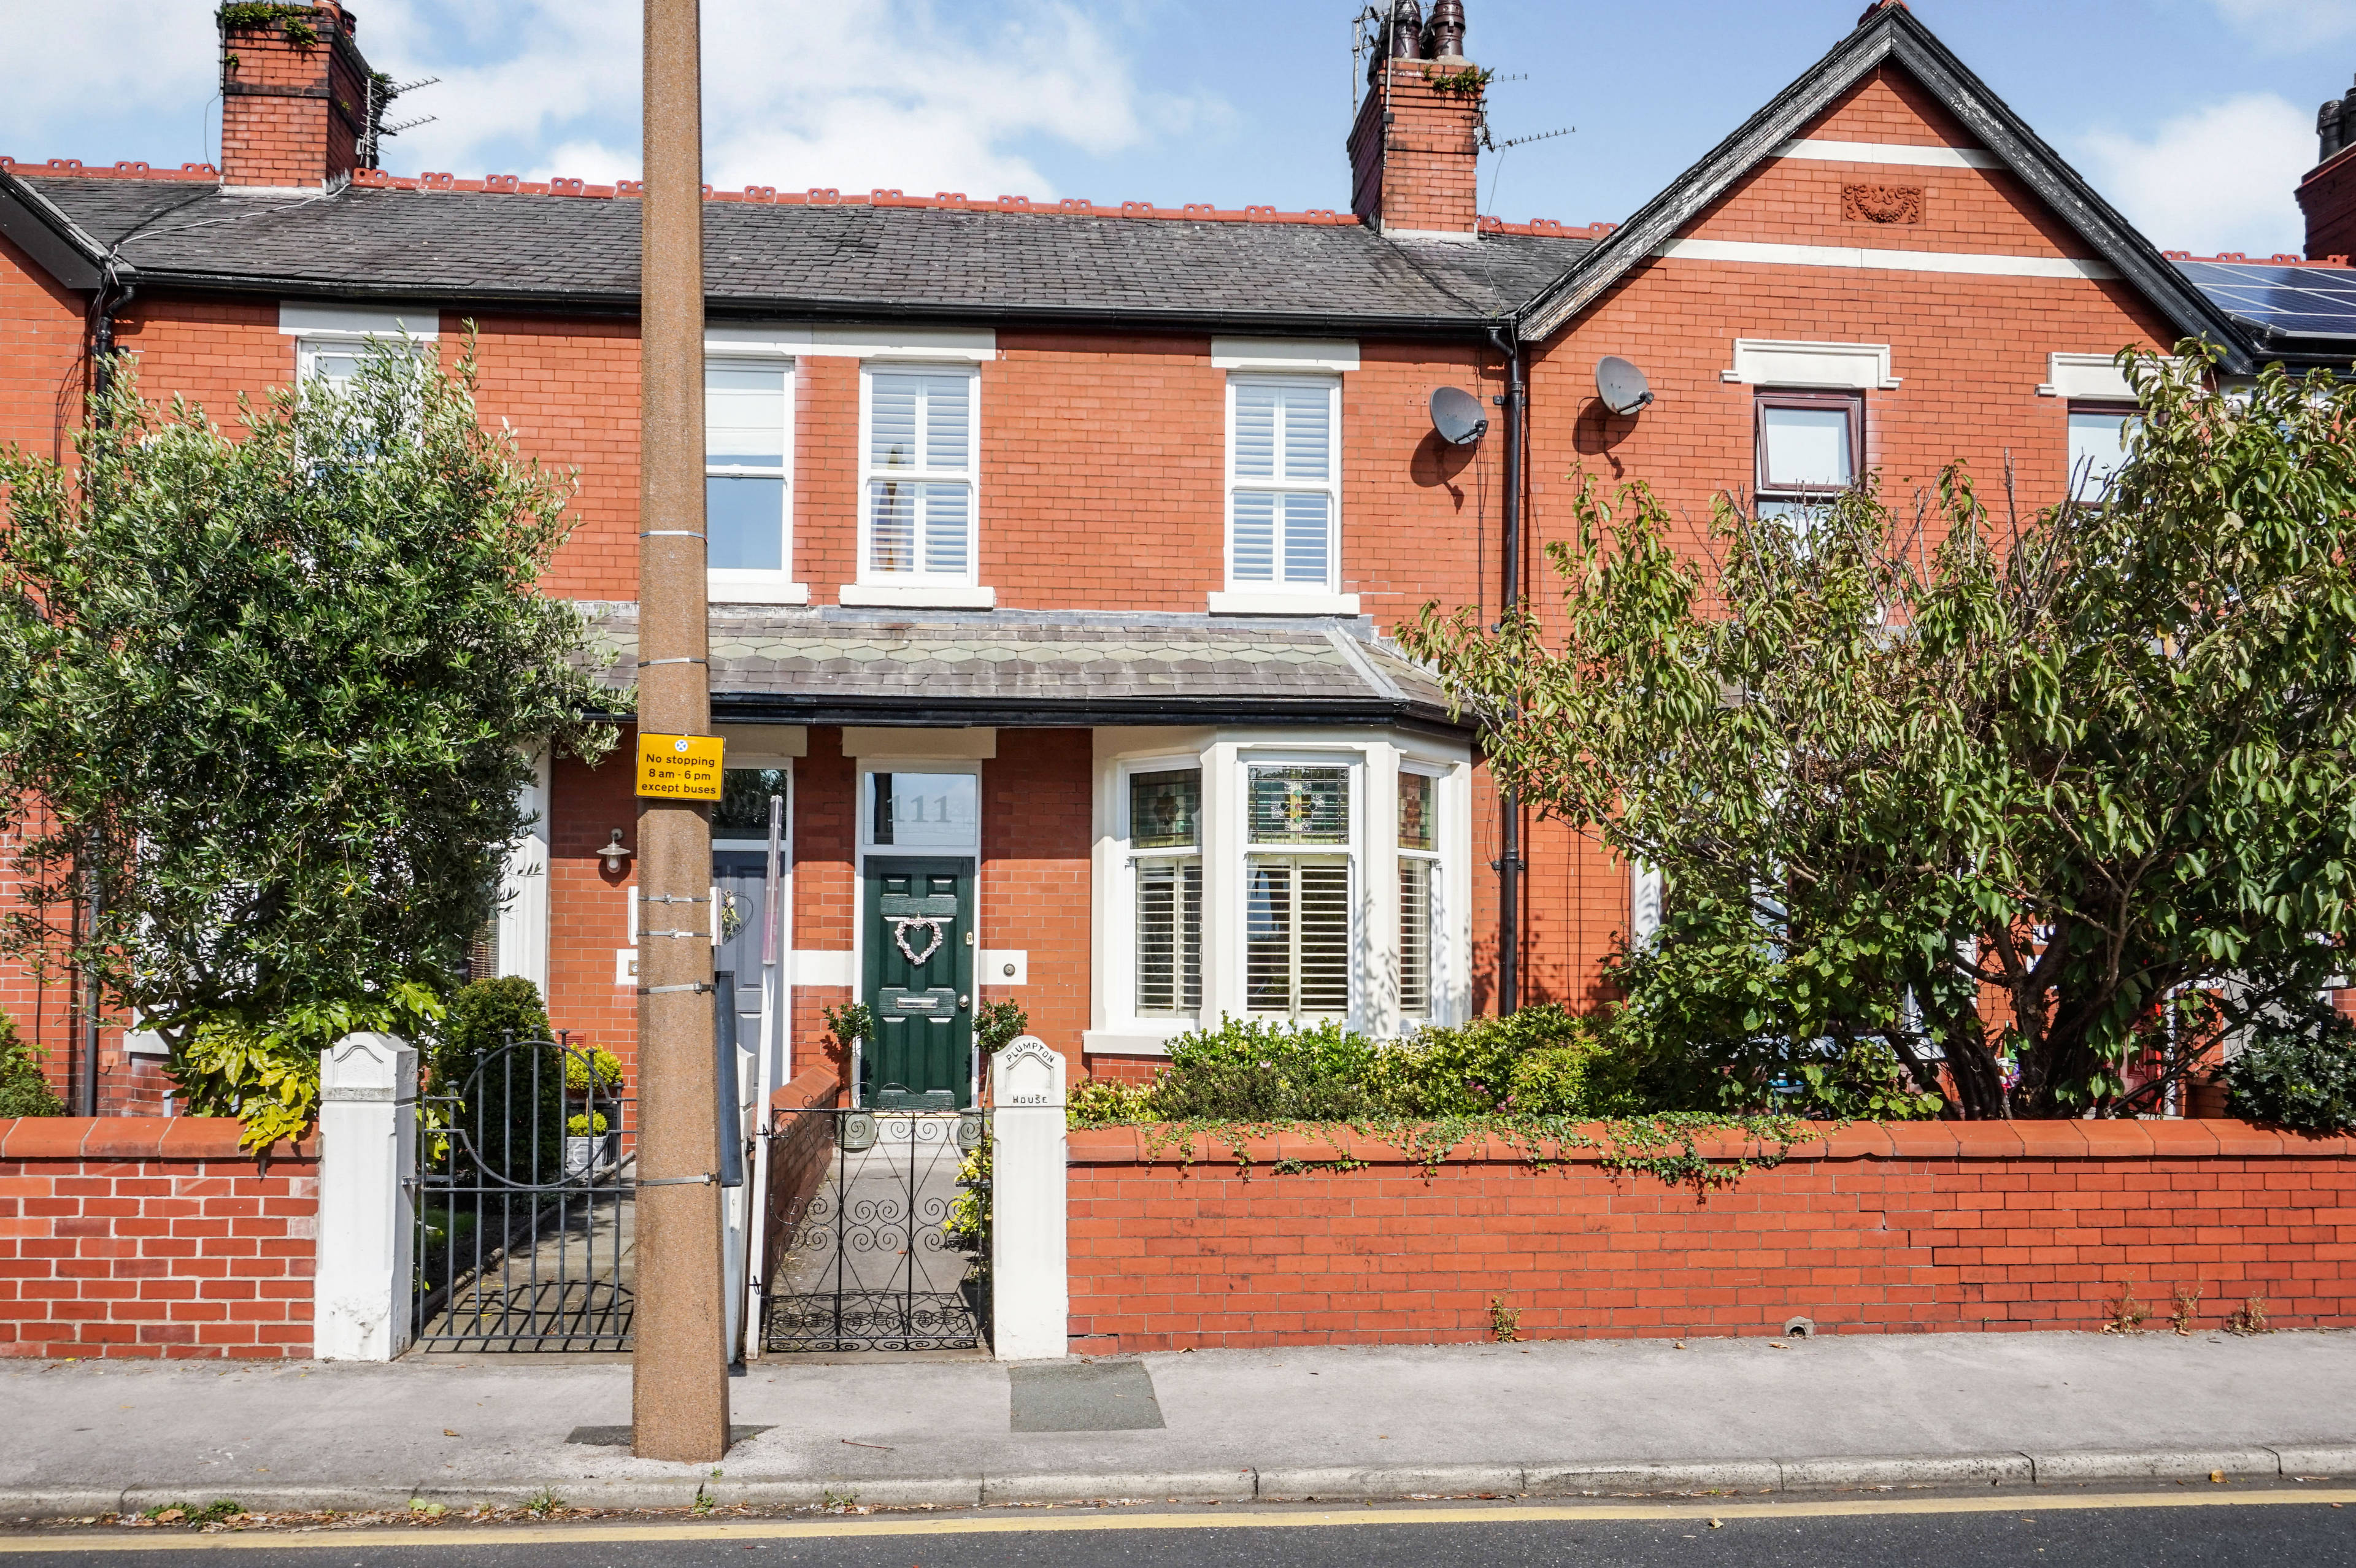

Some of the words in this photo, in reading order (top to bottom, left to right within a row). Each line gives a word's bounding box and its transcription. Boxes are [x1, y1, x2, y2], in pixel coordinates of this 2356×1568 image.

[646, 753, 661, 763] No
[666, 755, 715, 767] stopping
[642, 783, 679, 793] except
[683, 783, 716, 794] buses
[887, 794, 952, 823] 111
[1006, 1042, 1055, 1063] PLUMPTON
[1013, 1095, 1048, 1104] HOUSE
